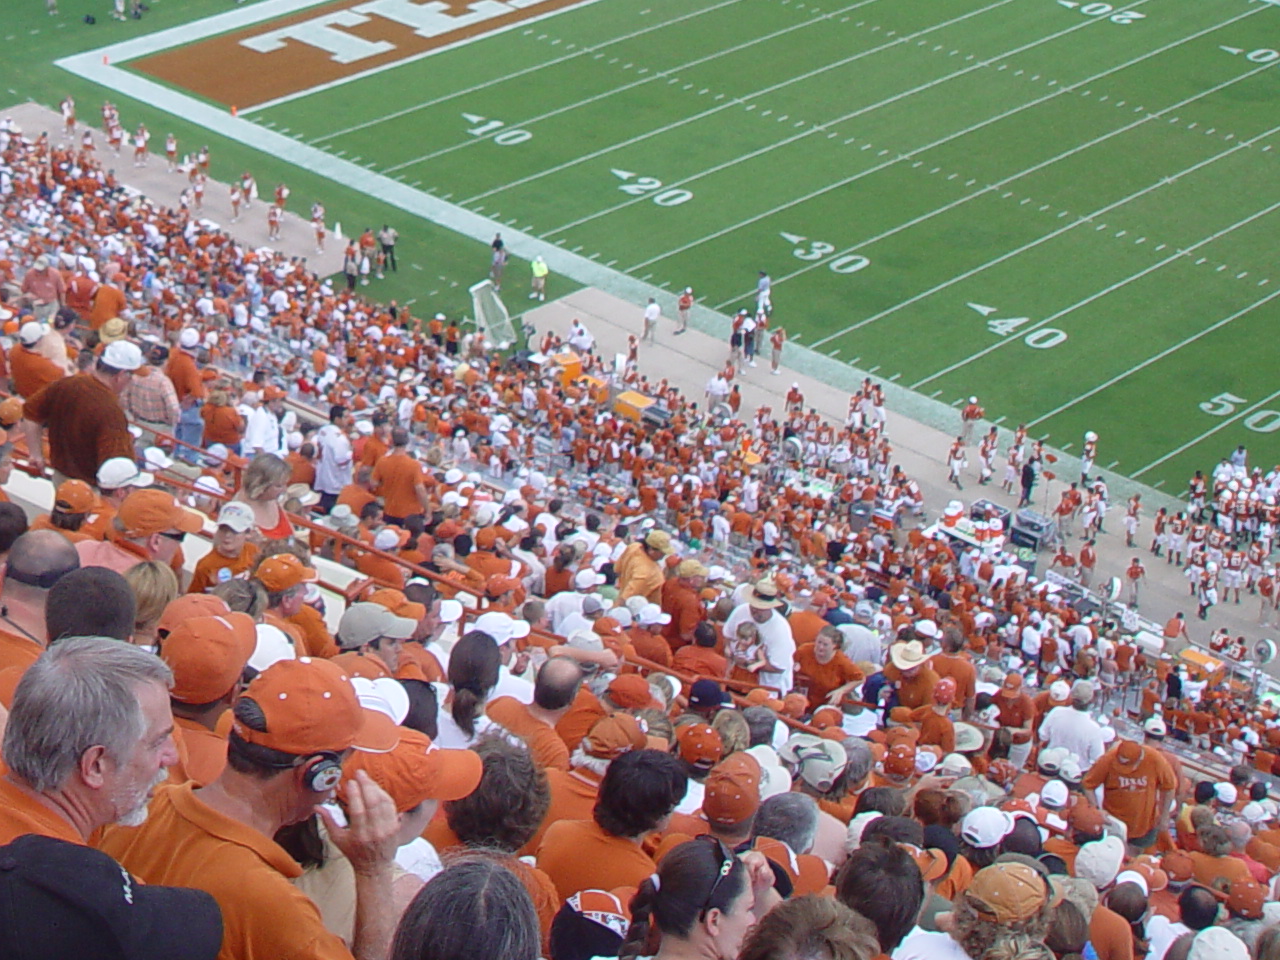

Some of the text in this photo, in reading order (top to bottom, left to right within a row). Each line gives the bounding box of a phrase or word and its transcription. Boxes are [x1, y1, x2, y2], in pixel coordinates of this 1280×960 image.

[468, 120, 532, 146] 10
[617, 177, 693, 207] 20
[793, 241, 870, 275] 30
[986, 315, 1068, 350] 40
[1199, 393, 1280, 434] 50
